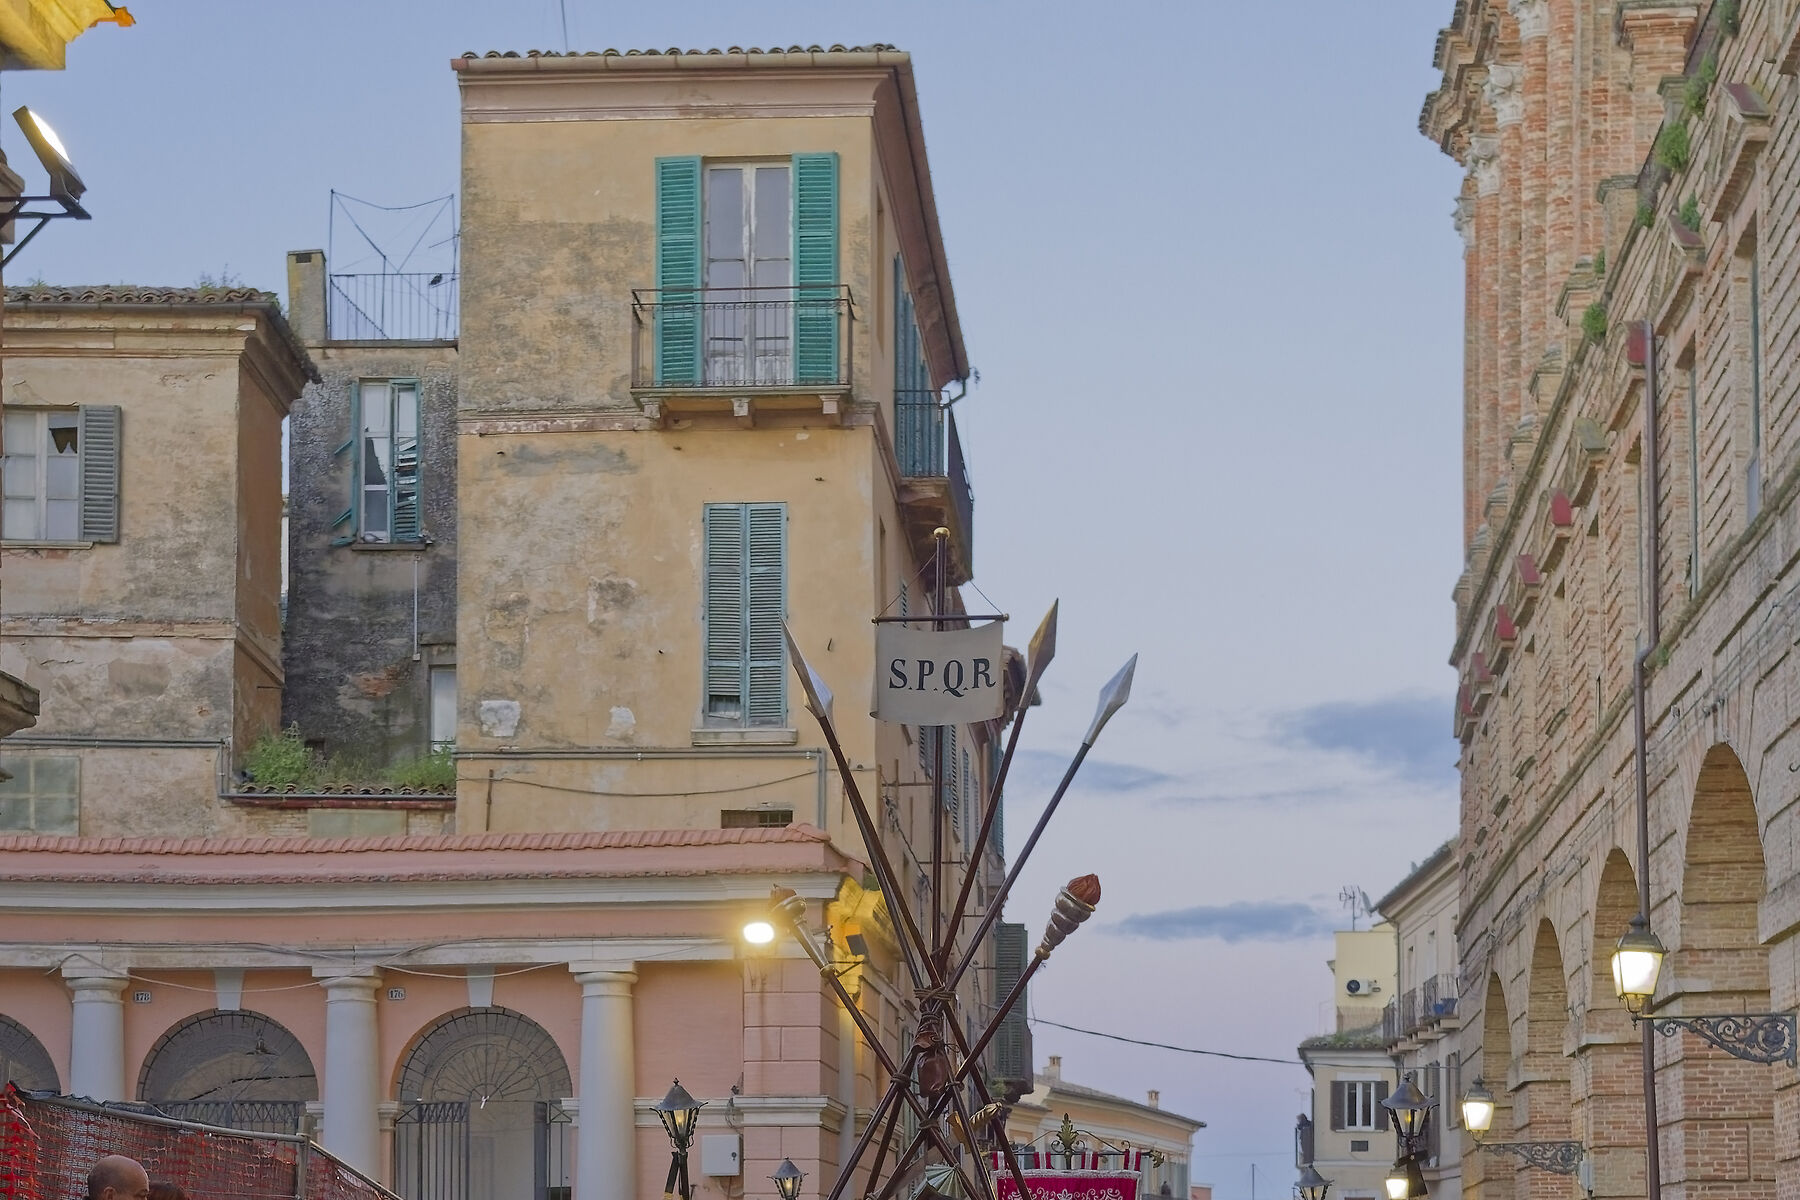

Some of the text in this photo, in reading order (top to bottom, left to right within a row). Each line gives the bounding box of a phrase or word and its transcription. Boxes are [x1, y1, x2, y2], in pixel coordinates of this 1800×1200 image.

[889, 658, 996, 697] S.P.Q.R
[135, 992, 150, 1001] 178
[390, 989, 403, 999] 176
